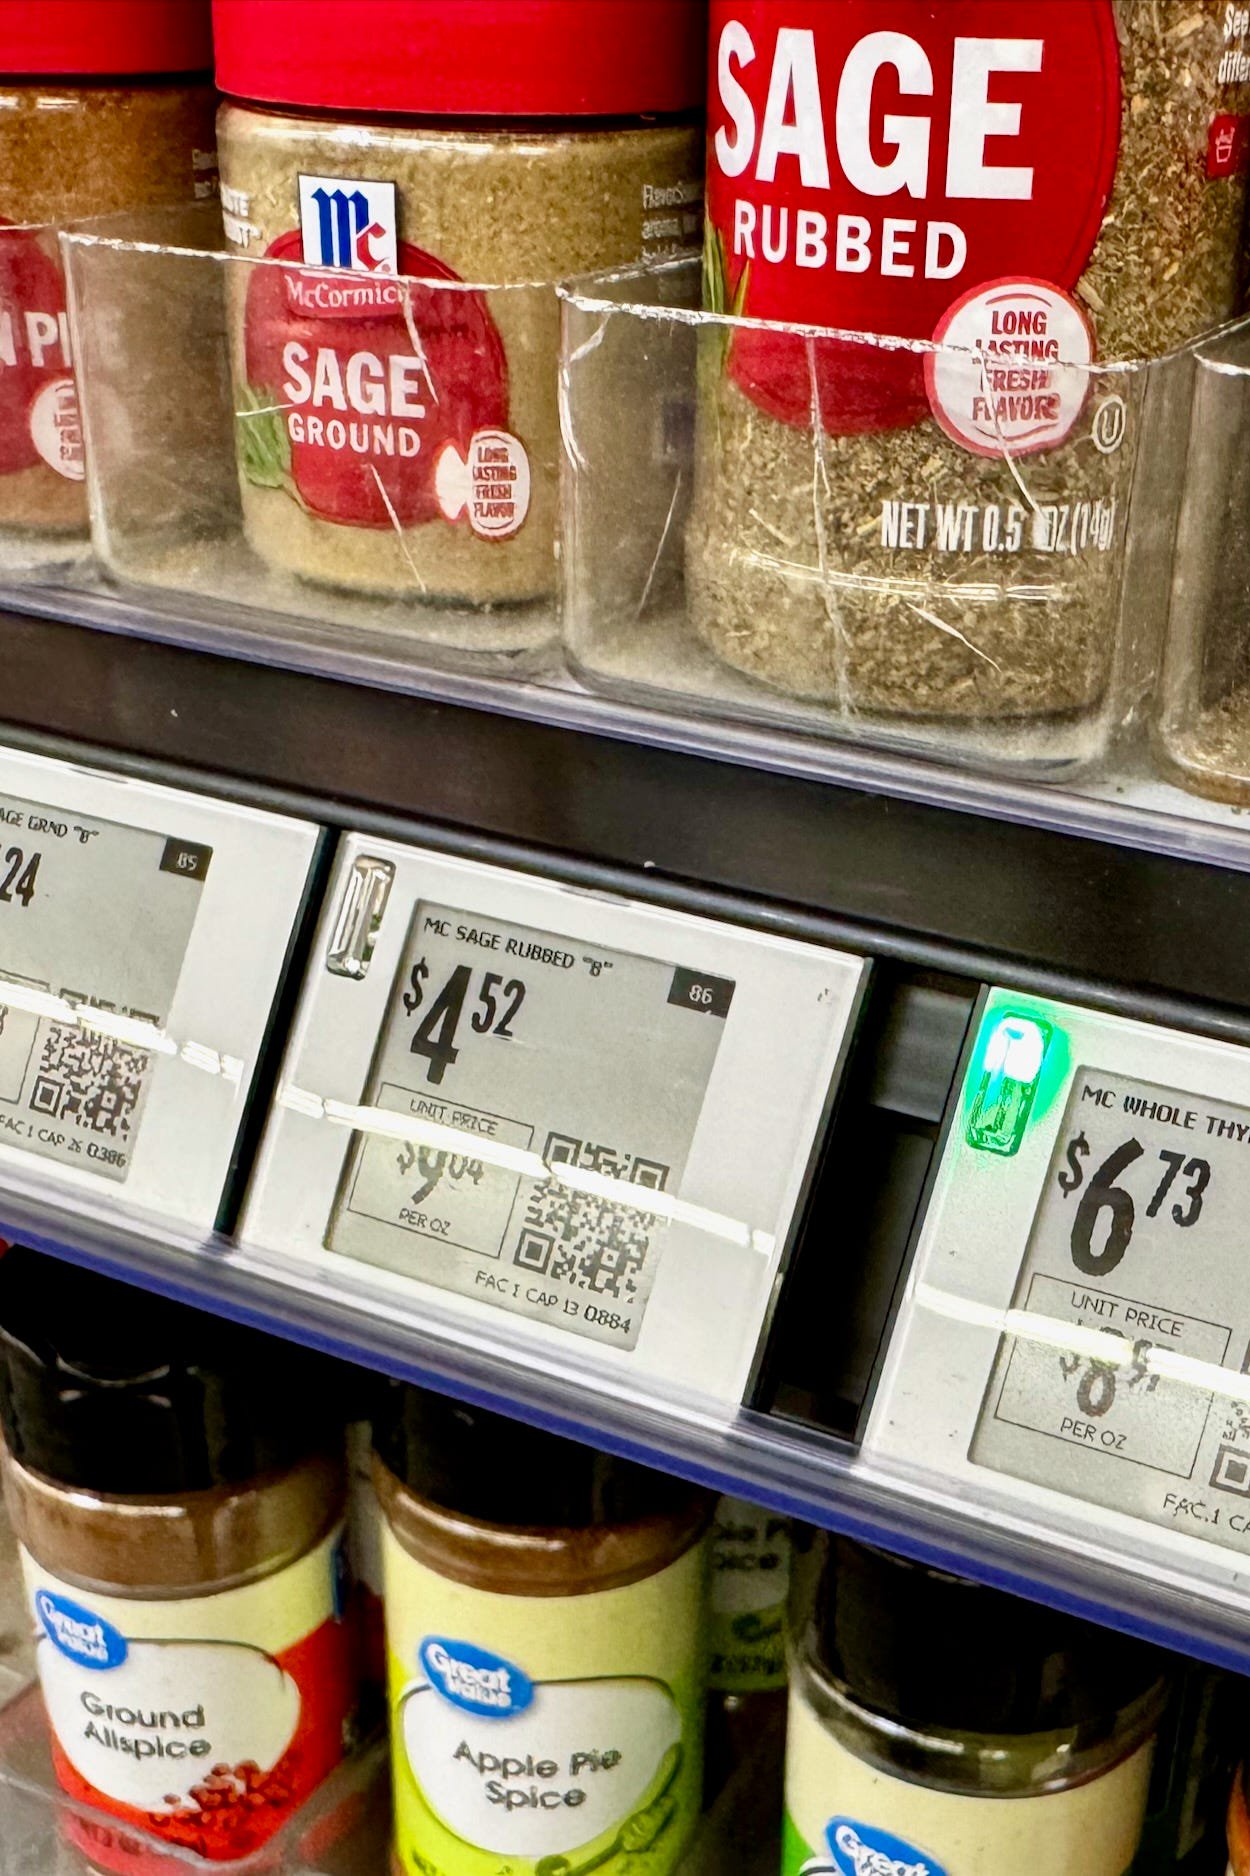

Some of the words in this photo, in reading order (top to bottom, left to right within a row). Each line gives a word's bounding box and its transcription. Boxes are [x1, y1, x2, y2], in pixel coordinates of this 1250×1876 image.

[714, 20, 1044, 200] SAGE
[733, 200, 968, 281] RUBBED
[991, 311, 1048, 336] LONG
[282, 341, 426, 418] SAGE
[980, 369, 1049, 393] FRESH
[288, 412, 421, 457] GROUND
[881, 499, 931, 550] NET
[936, 502, 980, 552] WT
[424, 917, 452, 937] MC
[456, 925, 502, 950] SAGE
[505, 937, 576, 969] RUBBED
[689, 984, 714, 1005] 86
[410, 1098, 448, 1121] UNIT
[452, 1110, 499, 1136] PRICE
[1082, 1084, 1117, 1109] MC
[1123, 1095, 1199, 1131] WHOLE
[38, 1129, 66, 1148] CAP
[399, 1207, 428, 1229] PER
[430, 1217, 452, 1236] OZ
[475, 1270, 509, 1294] FAC
[526, 1288, 559, 1307] CAP
[563, 1298, 580, 1316] 13
[584, 1304, 632, 1335] 0884
[1071, 1290, 1119, 1318] UNIT
[1125, 1306, 1185, 1338] PRICE
[1060, 1416, 1097, 1442] PER
[1100, 1430, 1128, 1450] OZ
[426, 1643, 511, 1694] Great
[80, 1691, 206, 1729] Ground
[84, 1720, 212, 1760] Allspice
[452, 1740, 559, 1780] Apple
[570, 1748, 623, 1776] Pie
[485, 1779, 588, 1812] Spice
